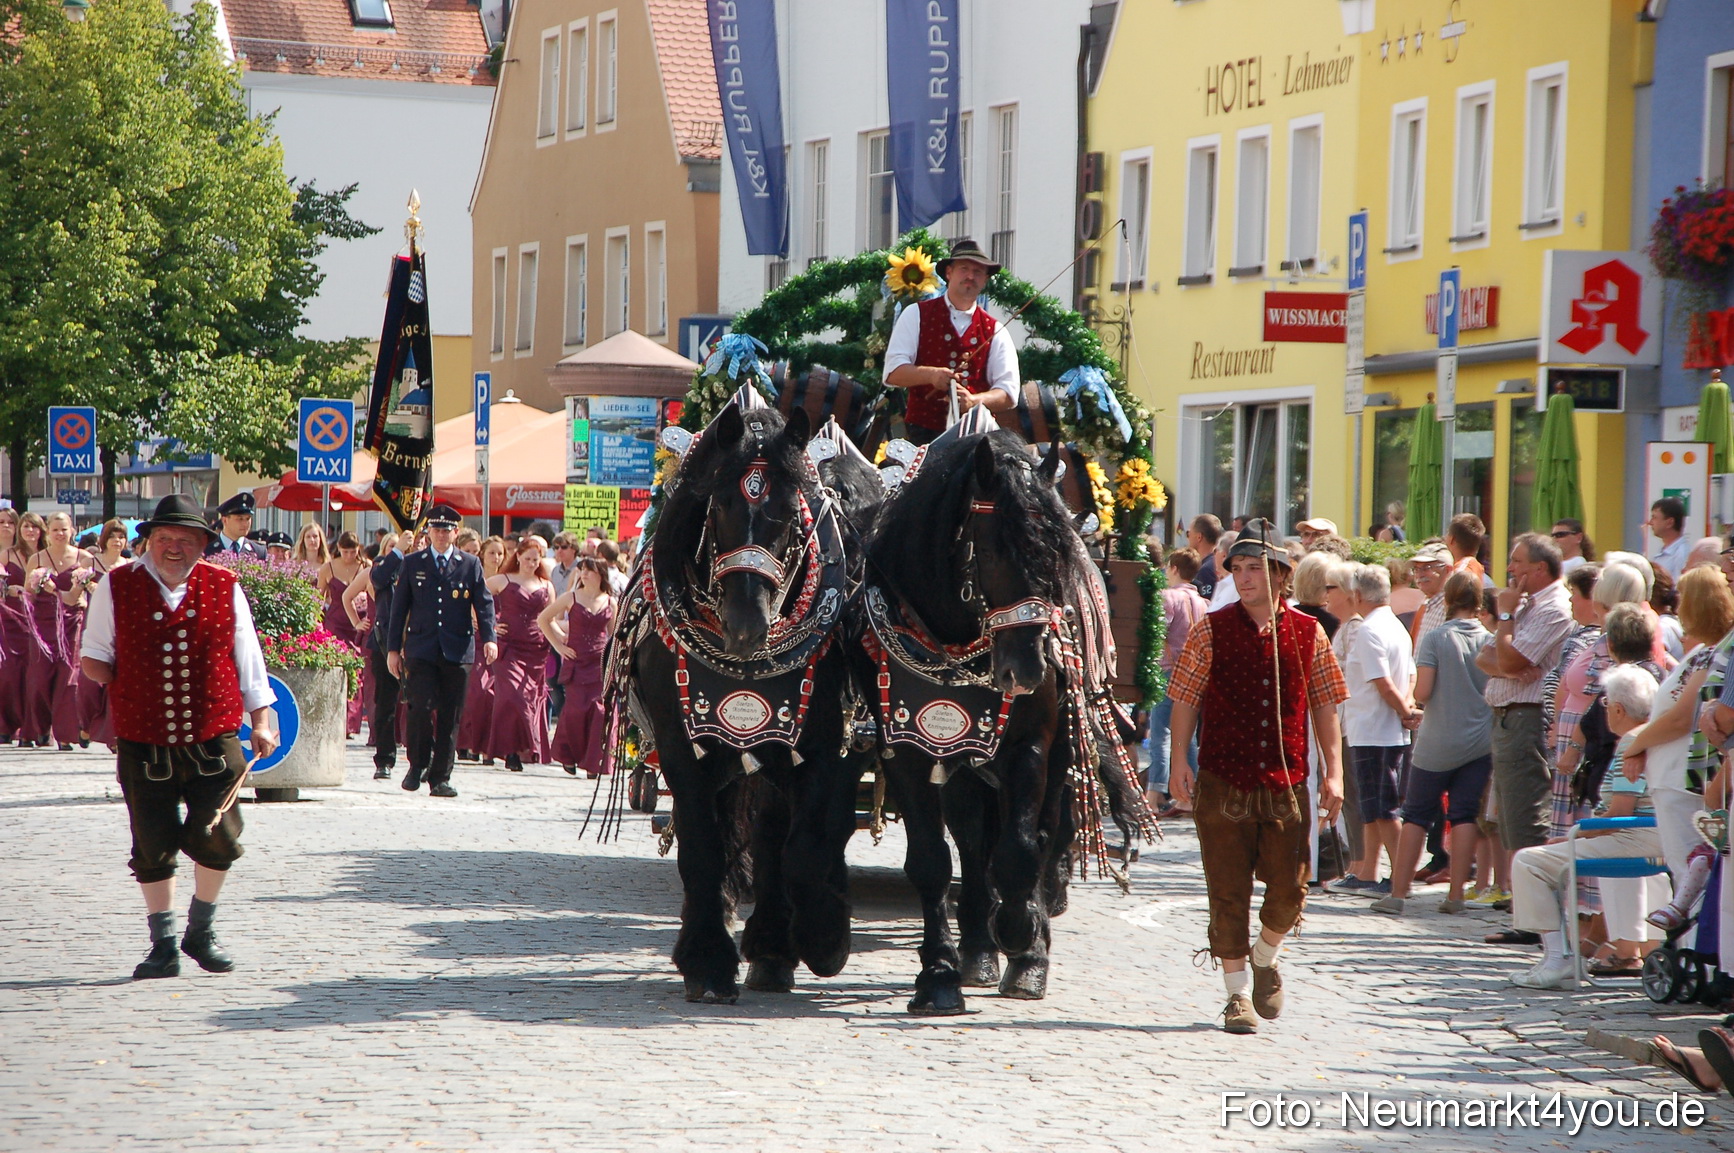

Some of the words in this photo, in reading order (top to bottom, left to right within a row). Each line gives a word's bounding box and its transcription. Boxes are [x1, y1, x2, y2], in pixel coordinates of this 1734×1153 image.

[927, 0, 950, 98] RUPP
[1206, 55, 1266, 117] HOTEL
[1282, 44, 1355, 96] Lehmeier
[928, 107, 949, 173] K&L
[1352, 223, 1364, 280] P
[1268, 308, 1348, 327] WISSMACH
[1442, 280, 1455, 339] P
[1190, 341, 1277, 380] Restaurant
[477, 379, 488, 422] P
[603, 404, 630, 412] LIEDER
[637, 404, 650, 412] SEE
[54, 454, 91, 469] TAXI
[303, 456, 347, 477] TAXI
[381, 441, 433, 472] Bernga
[505, 484, 563, 509] Glossner
[596, 489, 616, 499] Club
[620, 499, 650, 510] Sindl
